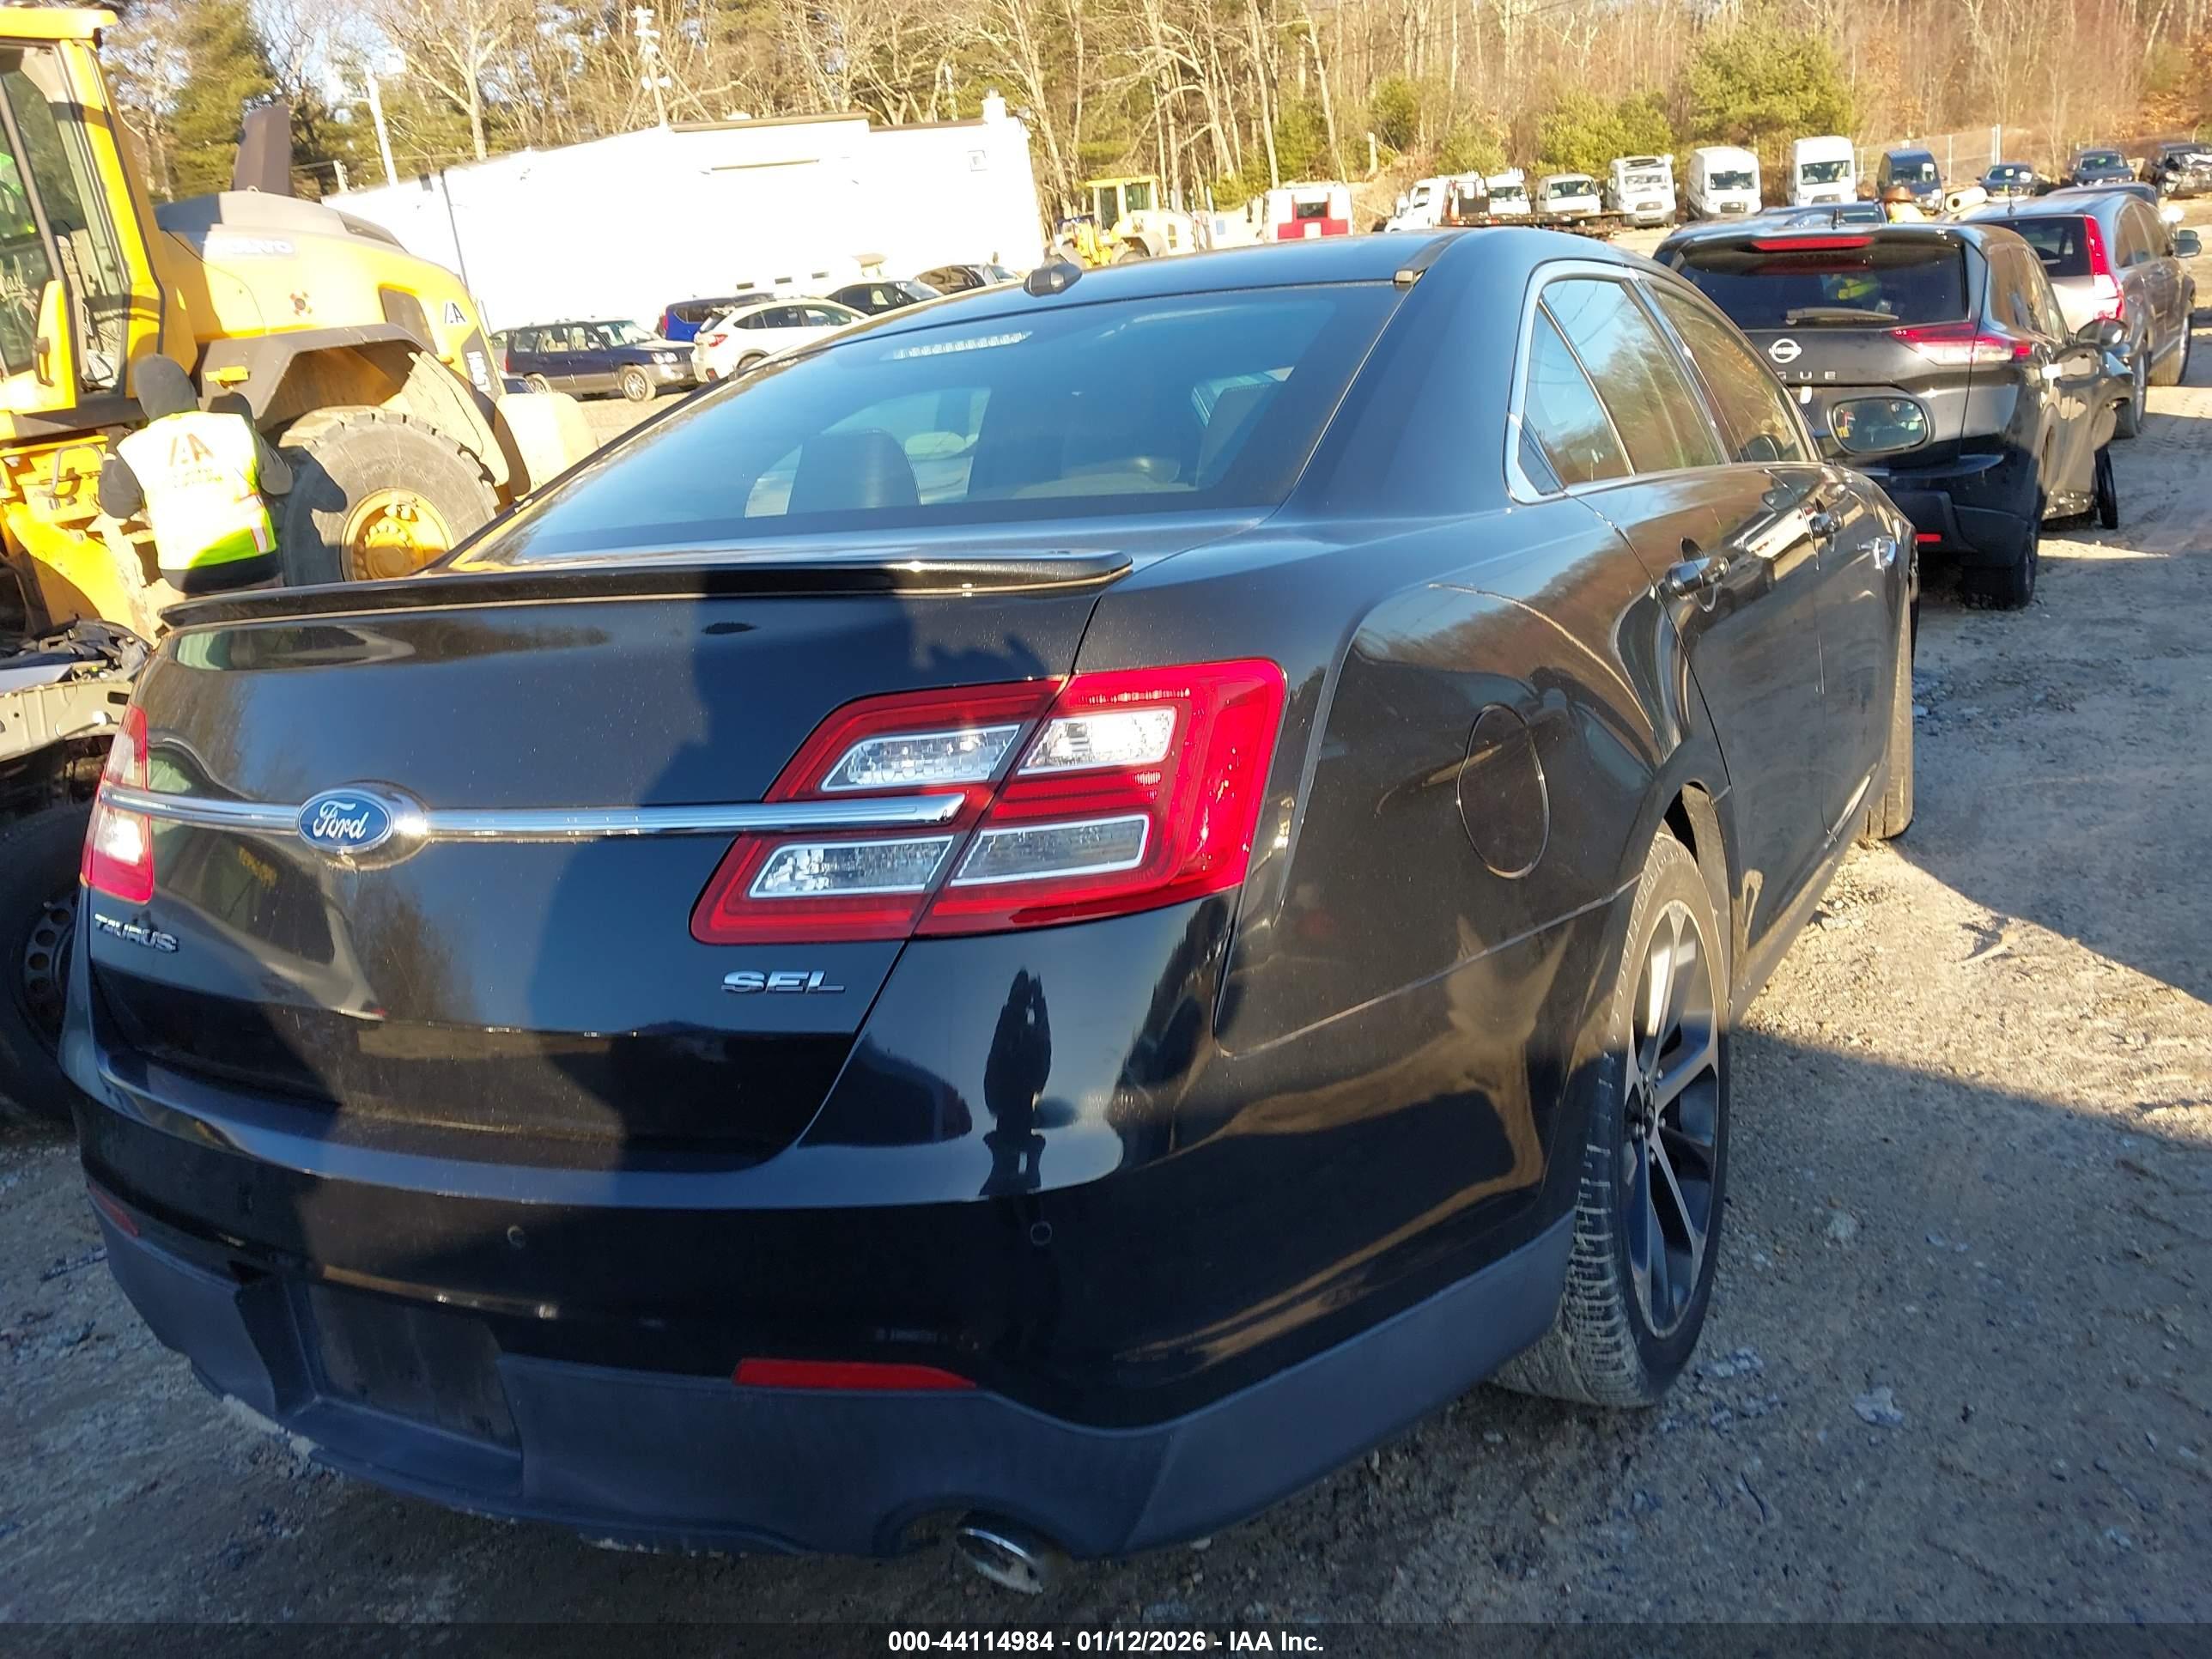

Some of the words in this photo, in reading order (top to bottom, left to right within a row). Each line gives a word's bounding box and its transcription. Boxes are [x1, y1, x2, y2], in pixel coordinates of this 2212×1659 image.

[312, 799, 370, 839] Ford
[94, 913, 178, 952] TAURUS
[720, 970, 845, 994] SEL
